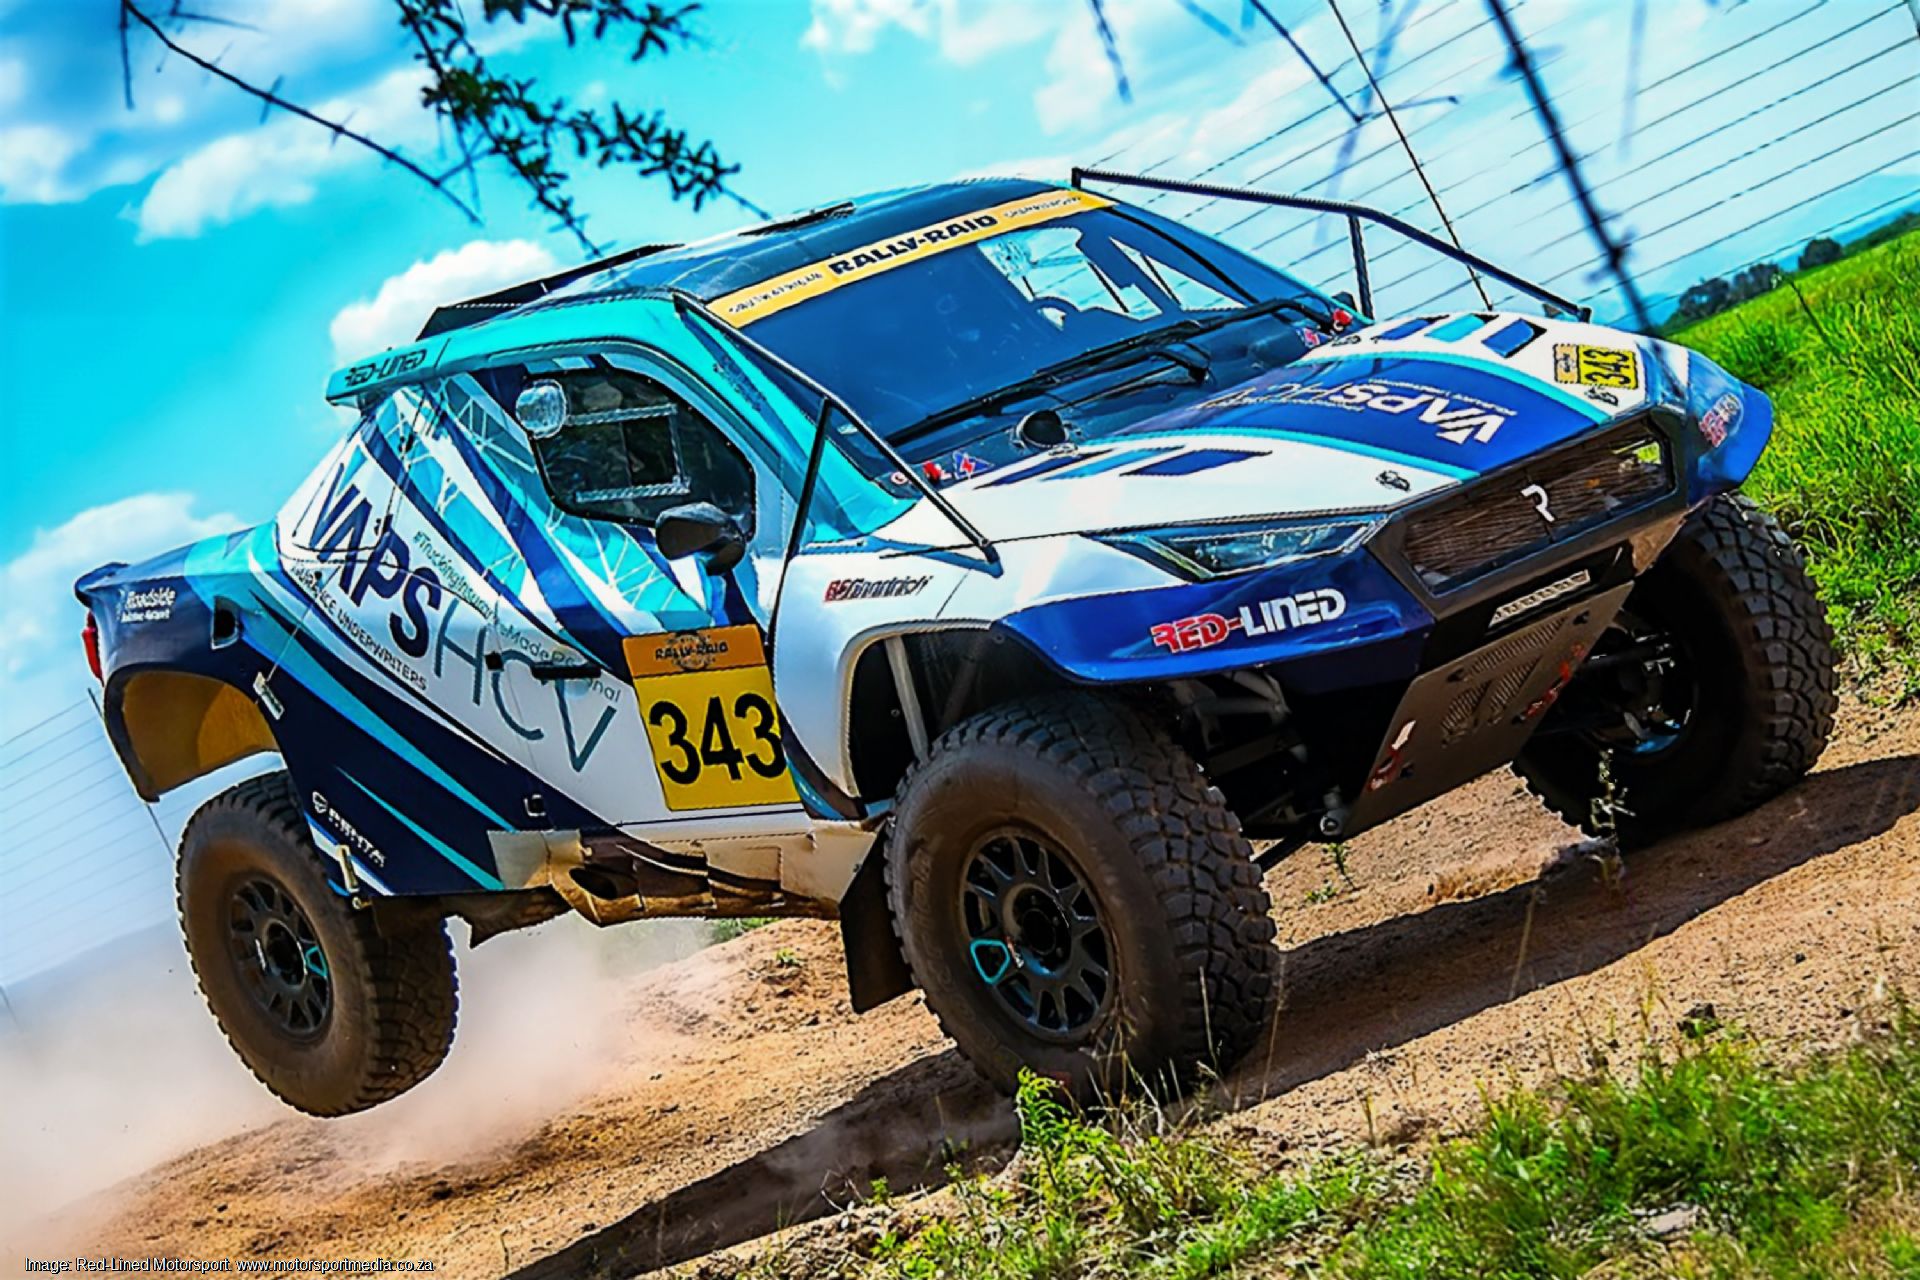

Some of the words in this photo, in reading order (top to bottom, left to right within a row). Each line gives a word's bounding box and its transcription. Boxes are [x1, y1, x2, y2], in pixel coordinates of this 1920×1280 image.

[828, 215, 998, 275] RALLY-RAID
[1582, 349, 1632, 386] 343
[1151, 588, 1346, 653] RED-LINED
[649, 693, 788, 785] 343
